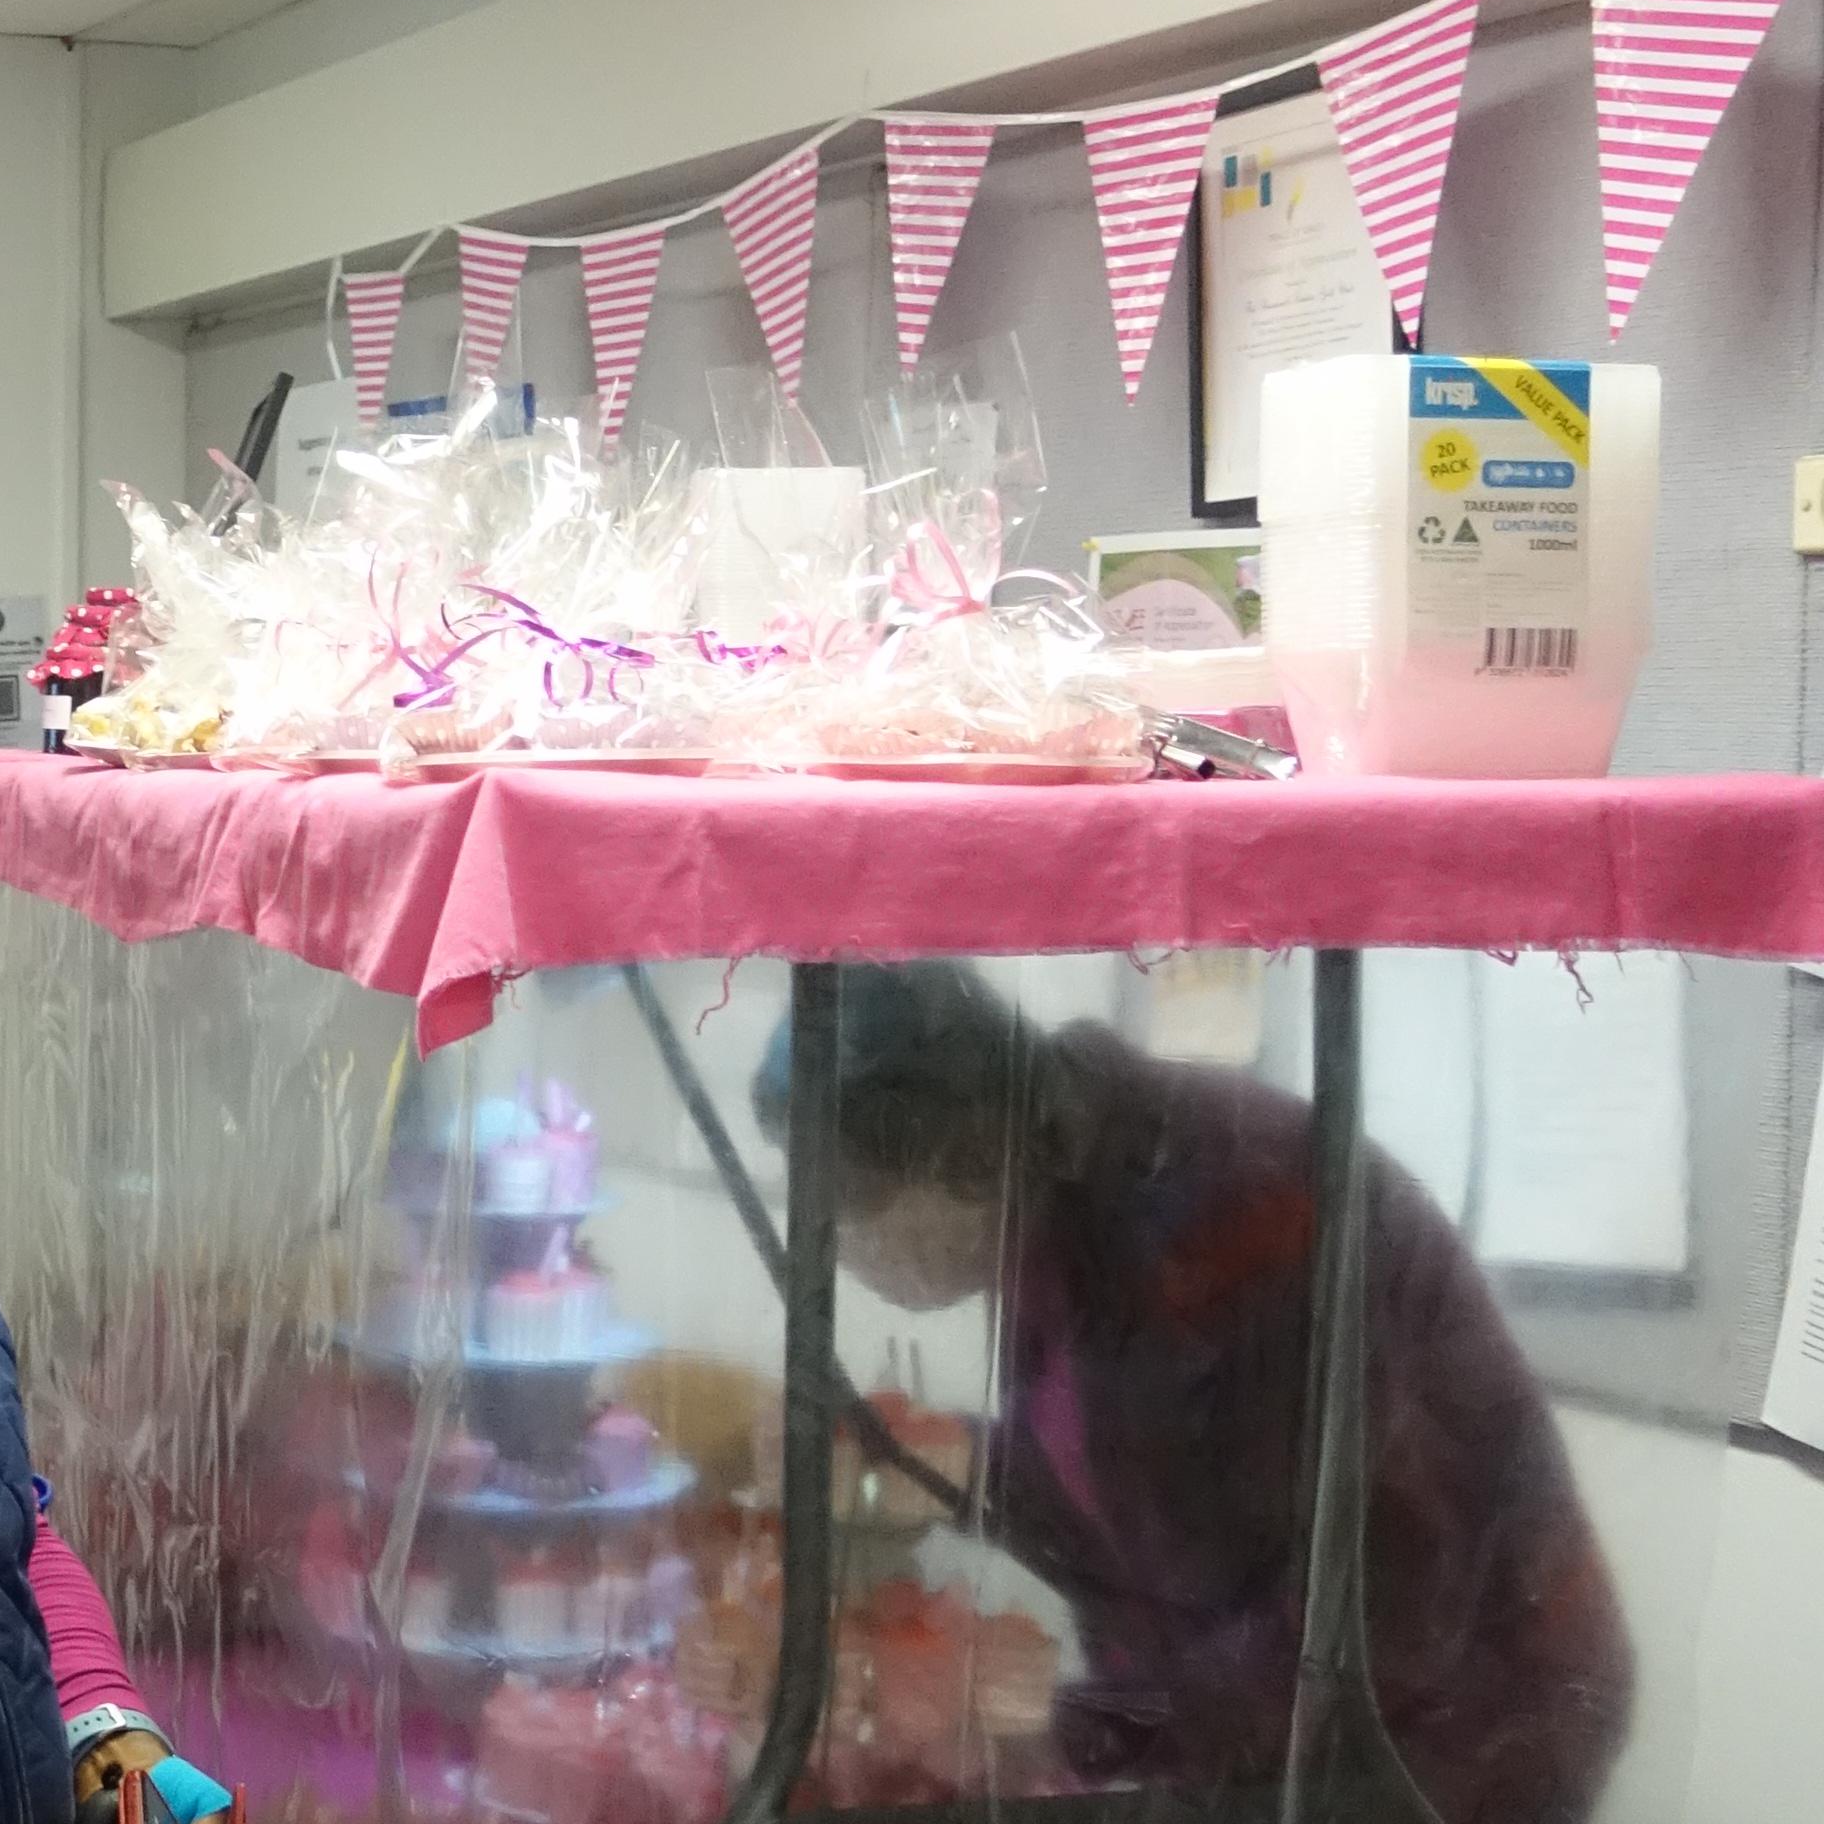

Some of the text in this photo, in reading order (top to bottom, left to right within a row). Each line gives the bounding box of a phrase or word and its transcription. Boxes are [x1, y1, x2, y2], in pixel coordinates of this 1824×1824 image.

[1515, 375, 1586, 444] VALUE PACK
[1437, 442, 1456, 458] 20
[1430, 459, 1471, 478] PACK
[1464, 500, 1578, 514] TAKEAWAY FOOD
[1492, 519, 1578, 533] CONTAINERS
